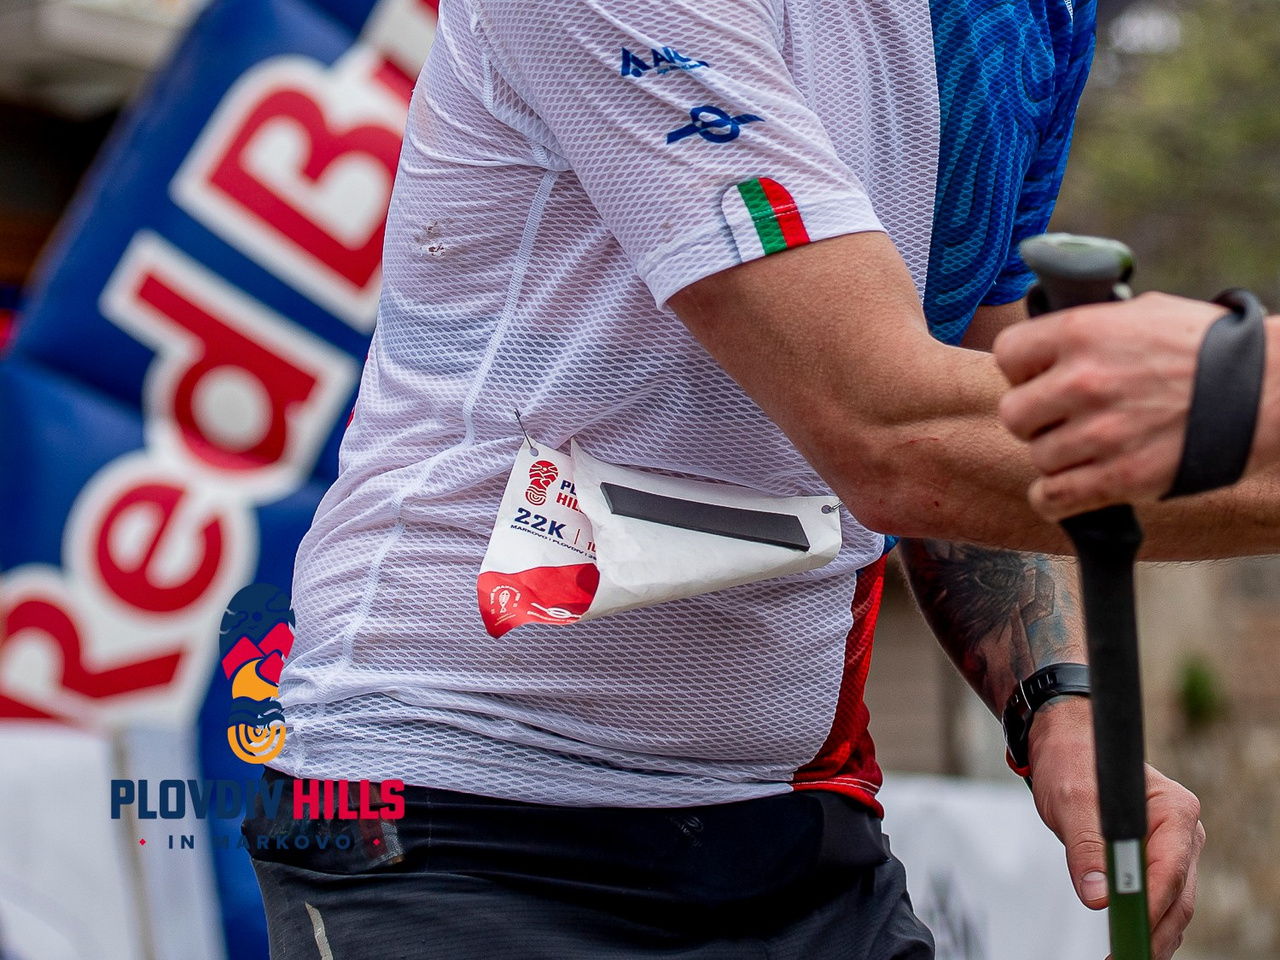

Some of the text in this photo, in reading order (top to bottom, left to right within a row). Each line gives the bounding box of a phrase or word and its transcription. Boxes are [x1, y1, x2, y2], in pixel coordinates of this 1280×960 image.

[0, 260, 325, 724] Red
[556, 492, 583, 514] HIL
[560, 479, 577, 496] PL
[514, 507, 567, 539] 22K
[510, 524, 549, 541] MARKOVO
[552, 539, 585, 555] PLOVDIV
